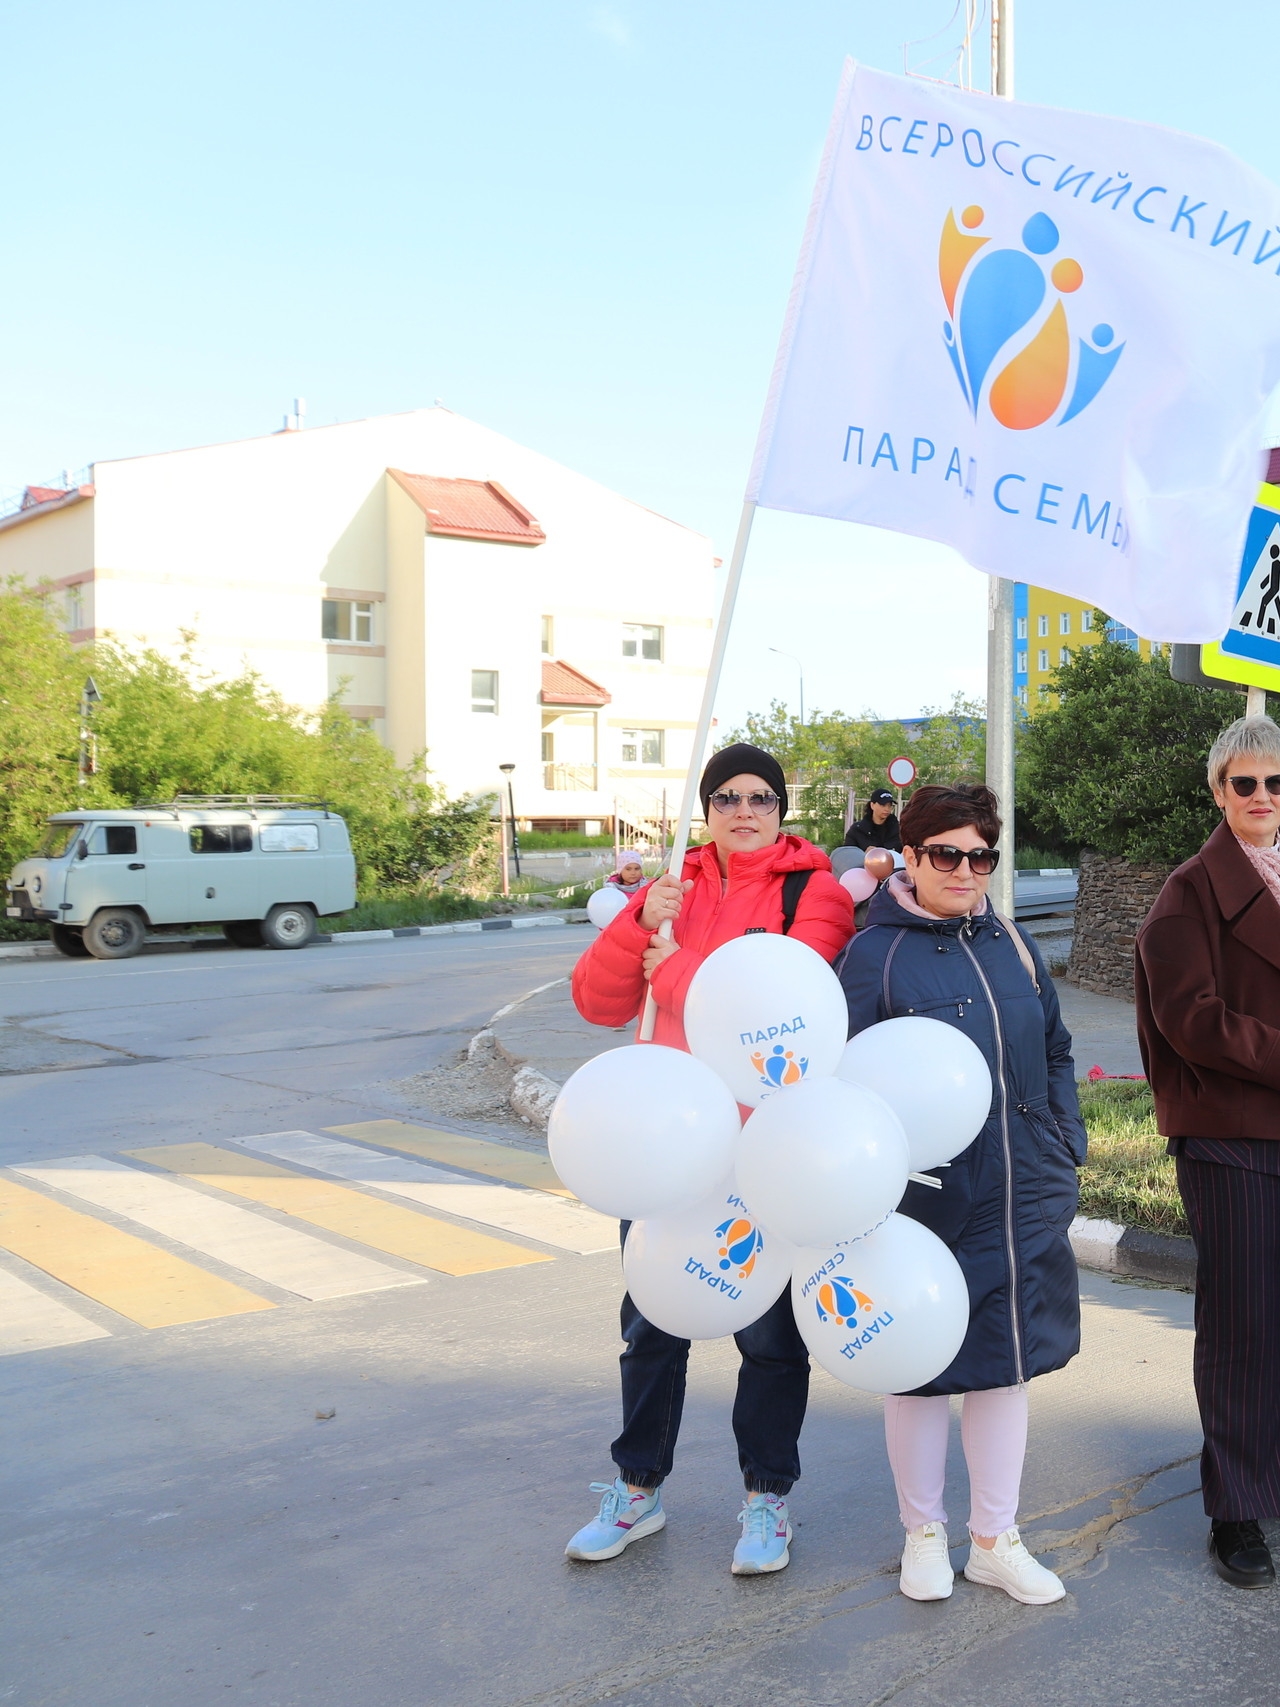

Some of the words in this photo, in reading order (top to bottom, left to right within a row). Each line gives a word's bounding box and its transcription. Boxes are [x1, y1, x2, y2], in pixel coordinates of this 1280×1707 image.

[739, 1016, 806, 1045] ПАРАД
[684, 1257, 743, 1300] ПАРАД
[801, 1252, 846, 1298] СЕМЬИ
[840, 1311, 895, 1360] ПАРАД
